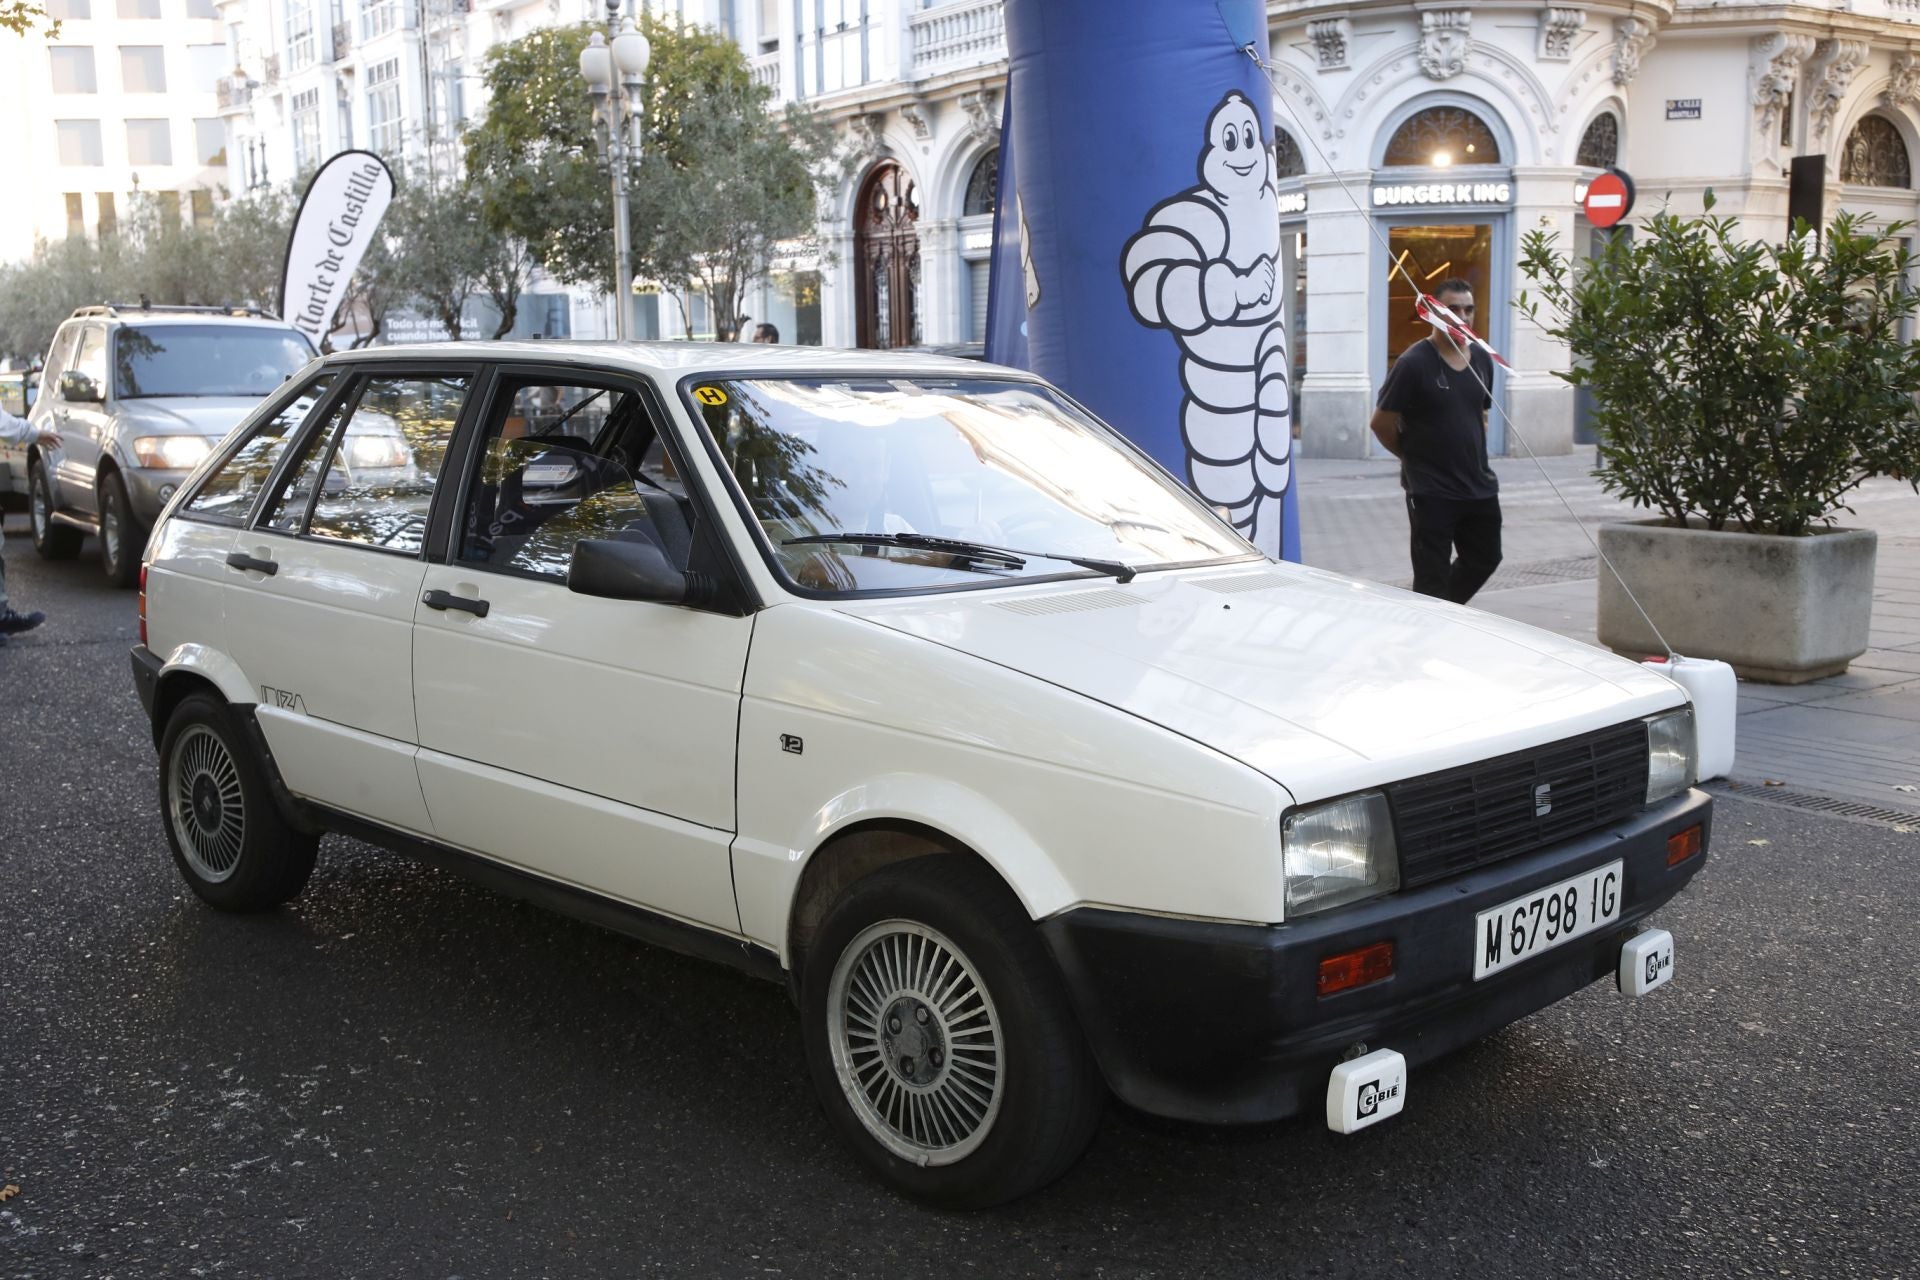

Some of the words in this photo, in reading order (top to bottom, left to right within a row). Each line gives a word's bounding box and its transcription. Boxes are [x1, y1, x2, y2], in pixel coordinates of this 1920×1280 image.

[328, 162, 382, 247] Castilla
[1374, 185, 1455, 205] BURGER
[1457, 184, 1510, 202] KING
[315, 249, 344, 273] de
[296, 274, 335, 335] Norte
[699, 389, 723, 403] H
[1485, 914, 1503, 969] M
[1510, 886, 1578, 956] 6798
[1591, 871, 1616, 924] IG
[1365, 1086, 1398, 1106] CIBIE
